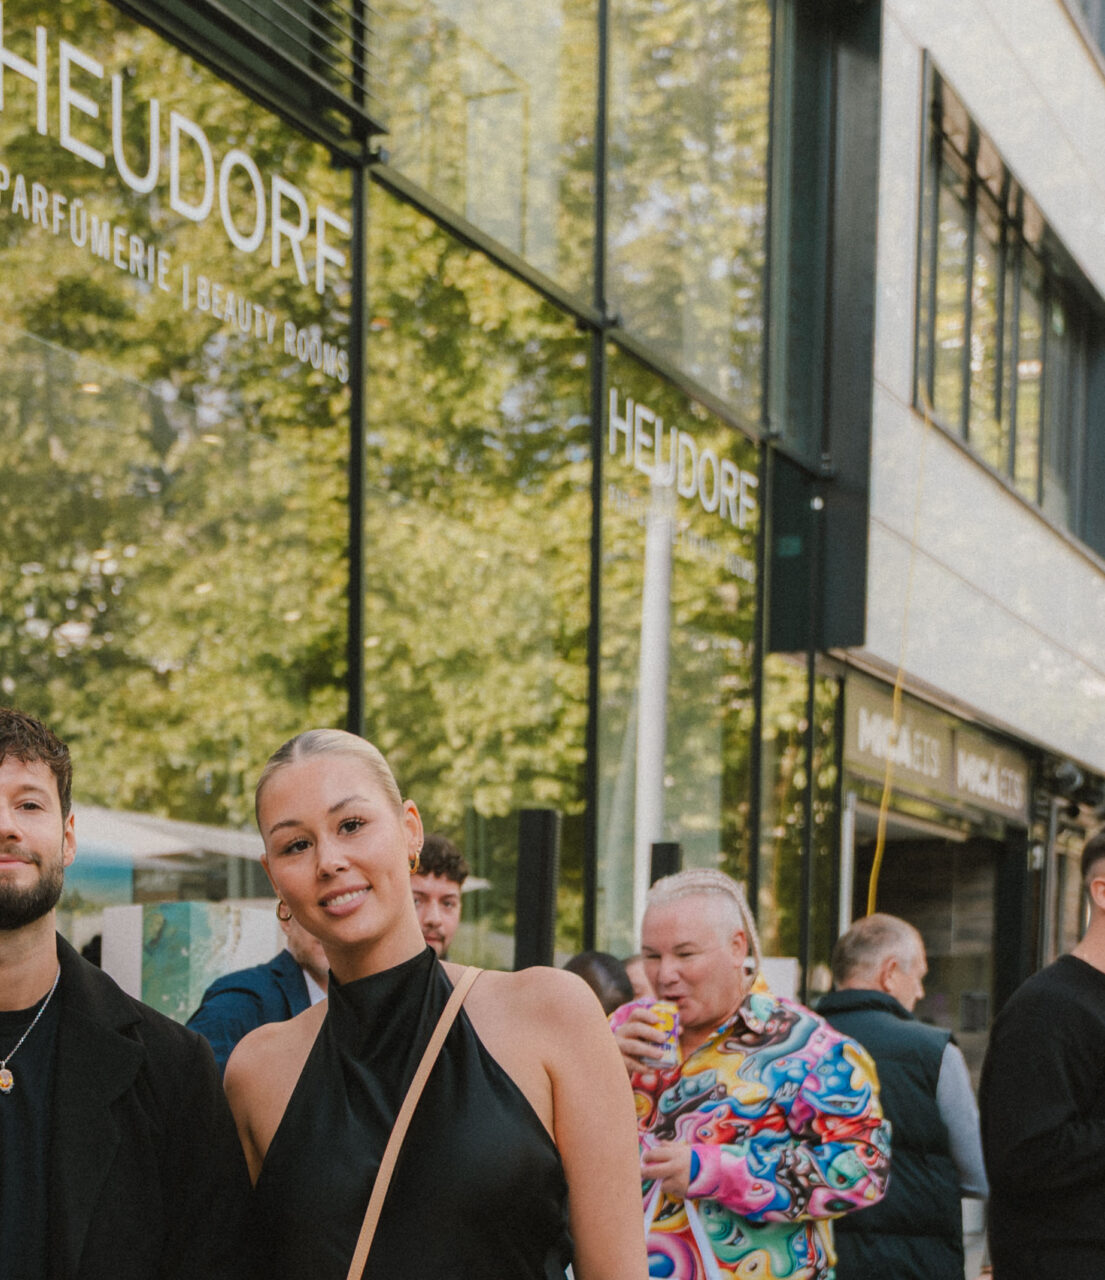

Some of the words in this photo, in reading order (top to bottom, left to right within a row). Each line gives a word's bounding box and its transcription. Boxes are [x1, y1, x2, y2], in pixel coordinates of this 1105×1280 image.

[197, 275, 276, 345] BEAUTY
[284, 320, 349, 383] ROOMS
[609, 387, 759, 530] HEUDORF
